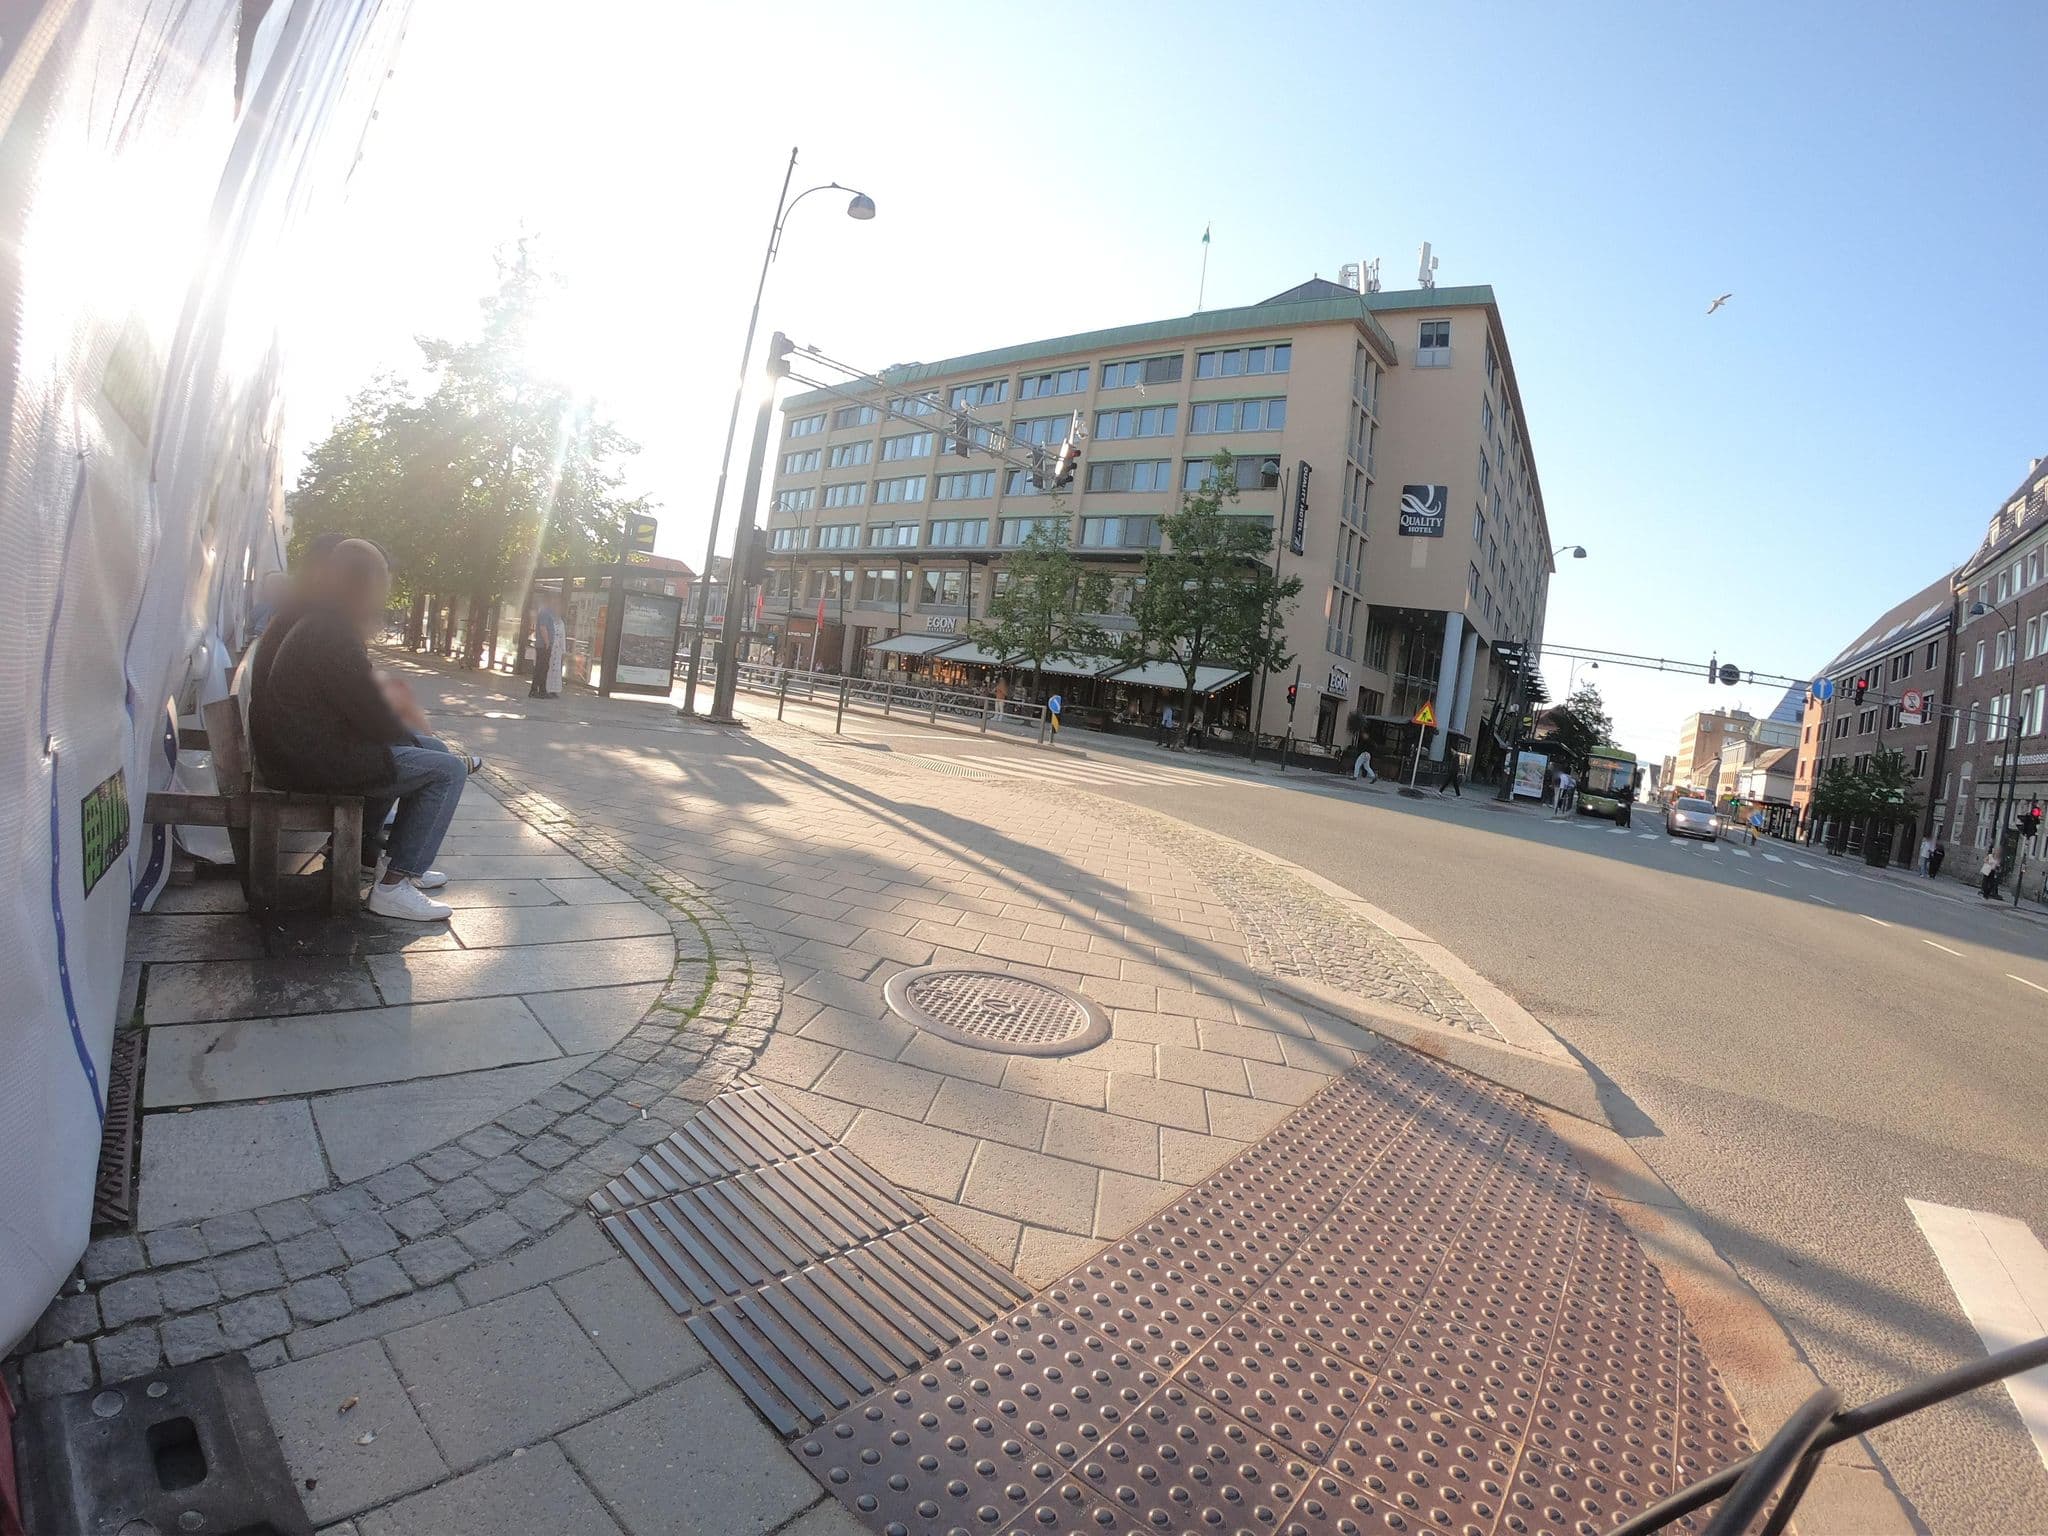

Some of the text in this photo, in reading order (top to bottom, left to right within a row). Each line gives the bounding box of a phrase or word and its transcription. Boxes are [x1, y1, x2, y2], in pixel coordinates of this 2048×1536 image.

[1297, 467, 1309, 532] QUALITY HOTEL
[1401, 514, 1443, 527] QUALITY
[927, 616, 956, 629] EGON
